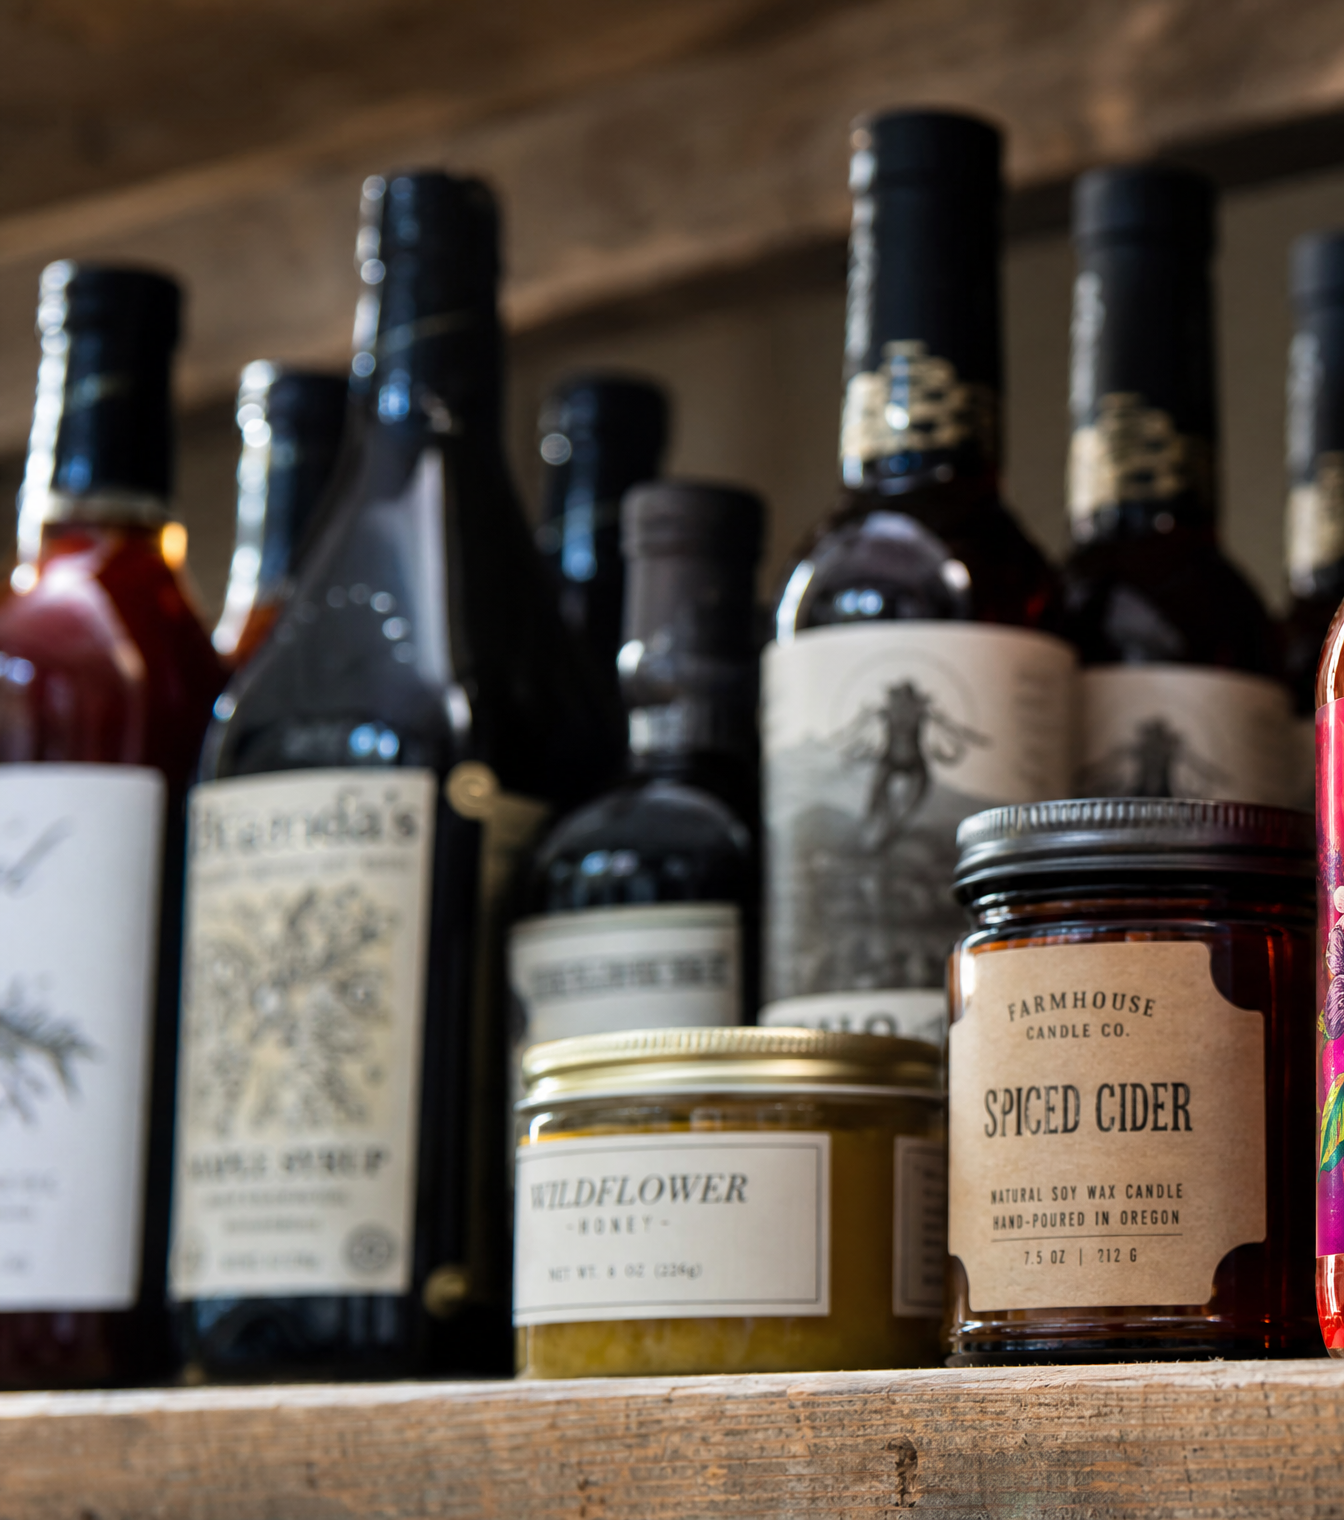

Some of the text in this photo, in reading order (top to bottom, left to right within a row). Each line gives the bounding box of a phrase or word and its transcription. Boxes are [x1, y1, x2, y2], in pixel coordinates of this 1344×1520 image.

[1008, 991, 1156, 1022] FARMHOUSE
[1026, 1023, 1130, 1040] CANDLE CO.
[984, 1082, 1193, 1138] SPICED CIDER
[529, 1173, 749, 1212] WILDFLOWER
[990, 1183, 1183, 1205] NATURAL SOY WAX CANDLE
[993, 1209, 1180, 1230] HAND-POURED IN OREGON
[1024, 1250, 1042, 1265] 7.5
[1050, 1249, 1065, 1264] OZ
[1098, 1248, 1120, 1263] 212
[1129, 1247, 1137, 1263] G
